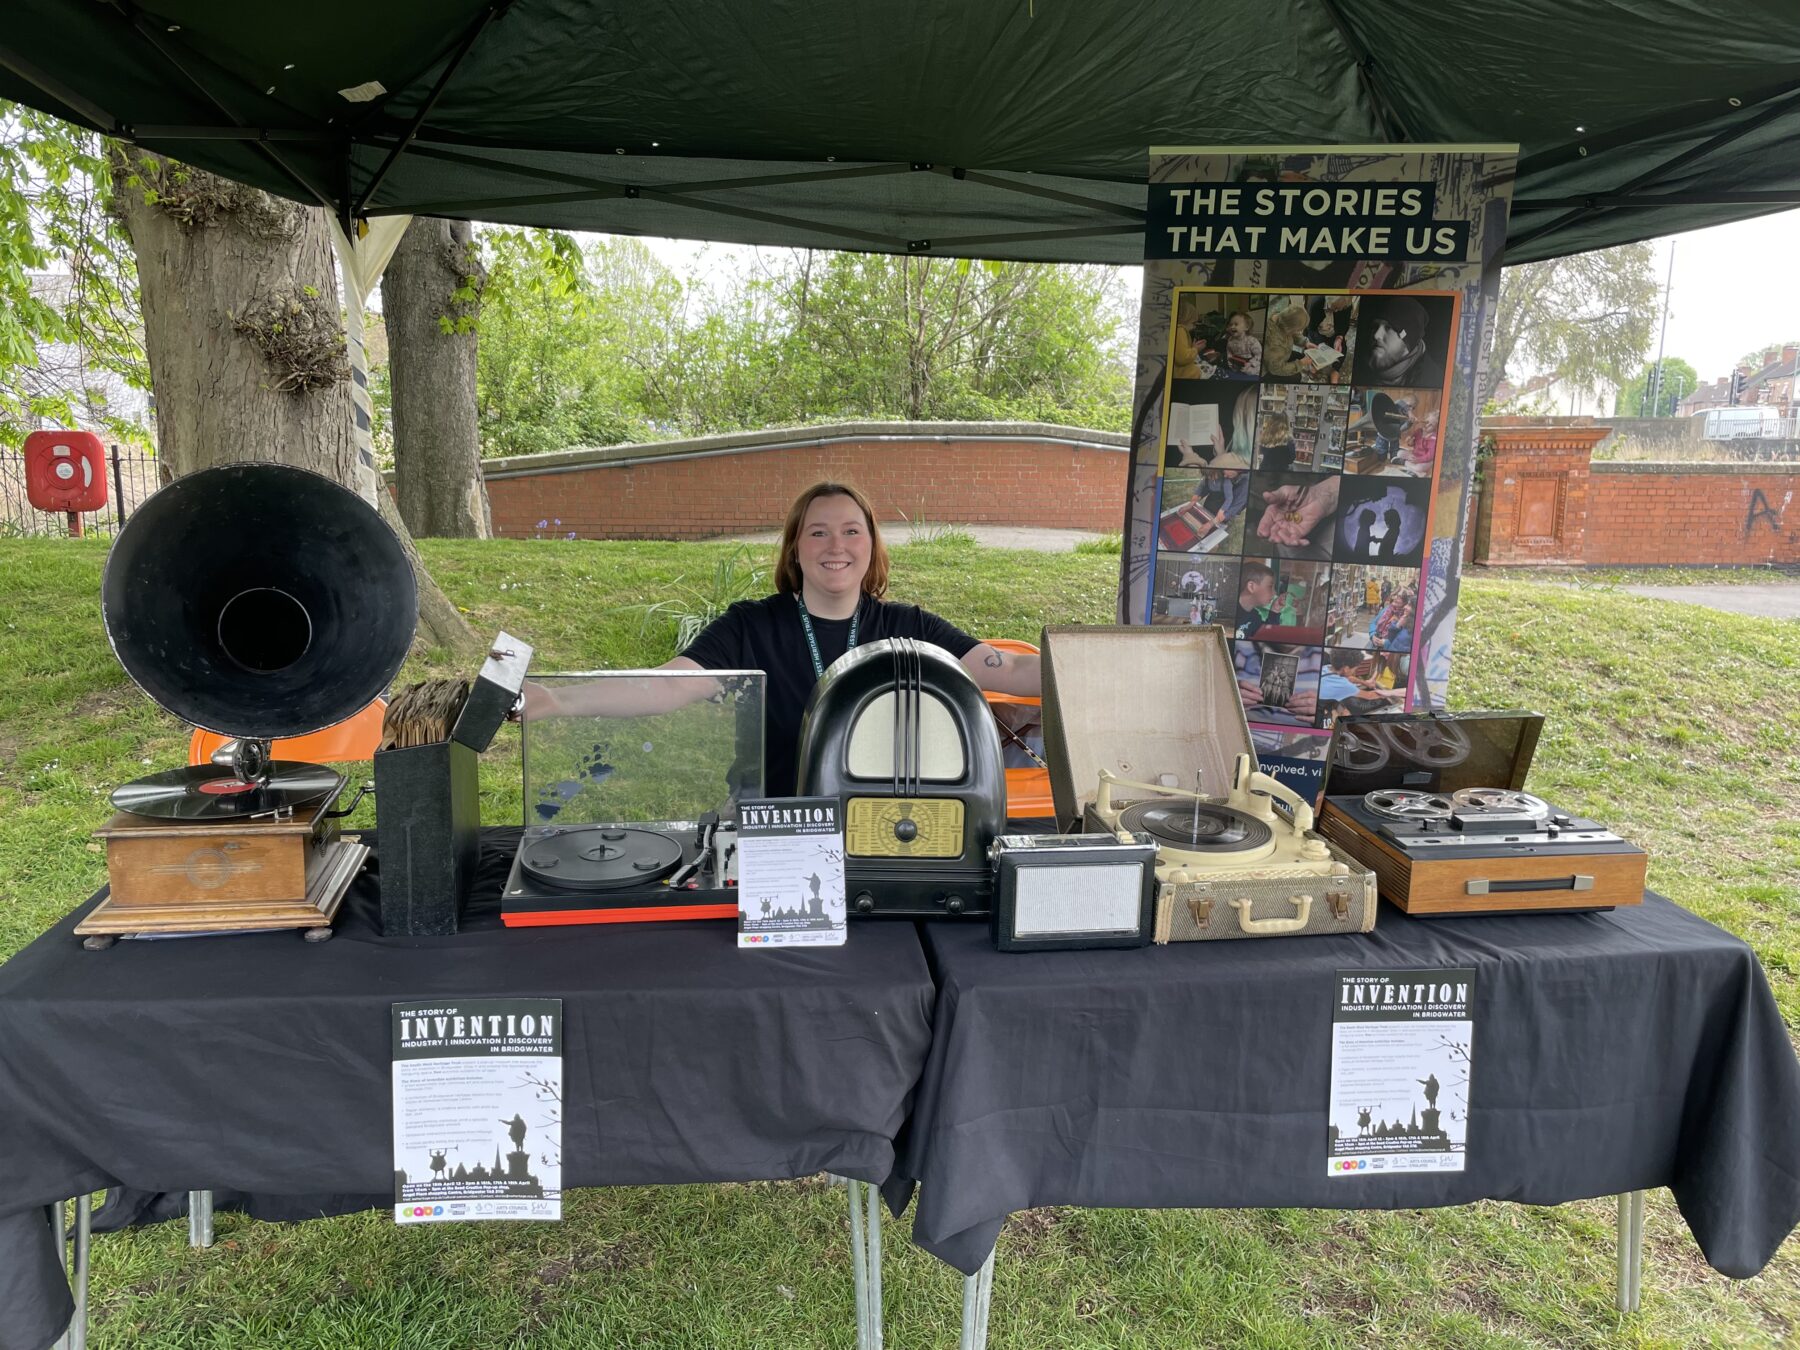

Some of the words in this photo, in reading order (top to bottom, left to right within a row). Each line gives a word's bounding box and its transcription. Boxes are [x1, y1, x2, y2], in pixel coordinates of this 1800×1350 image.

[1170, 189, 1241, 215] THE
[1254, 189, 1421, 216] STORIES
[1167, 226, 1266, 252] THAT
[1280, 227, 1391, 254] MAKE
[1406, 227, 1456, 254] US
[1482, 315, 1494, 363] MUST
[802, 614, 811, 632] TRUST
[808, 632, 820, 661] HERITAGE
[1260, 763, 1307, 776] nvolved,
[742, 808, 834, 824] INVENTION
[1341, 983, 1467, 1004] INVENTION
[401, 1015, 553, 1040] INVENTION
[402, 1040, 443, 1048] INDUSTRY
